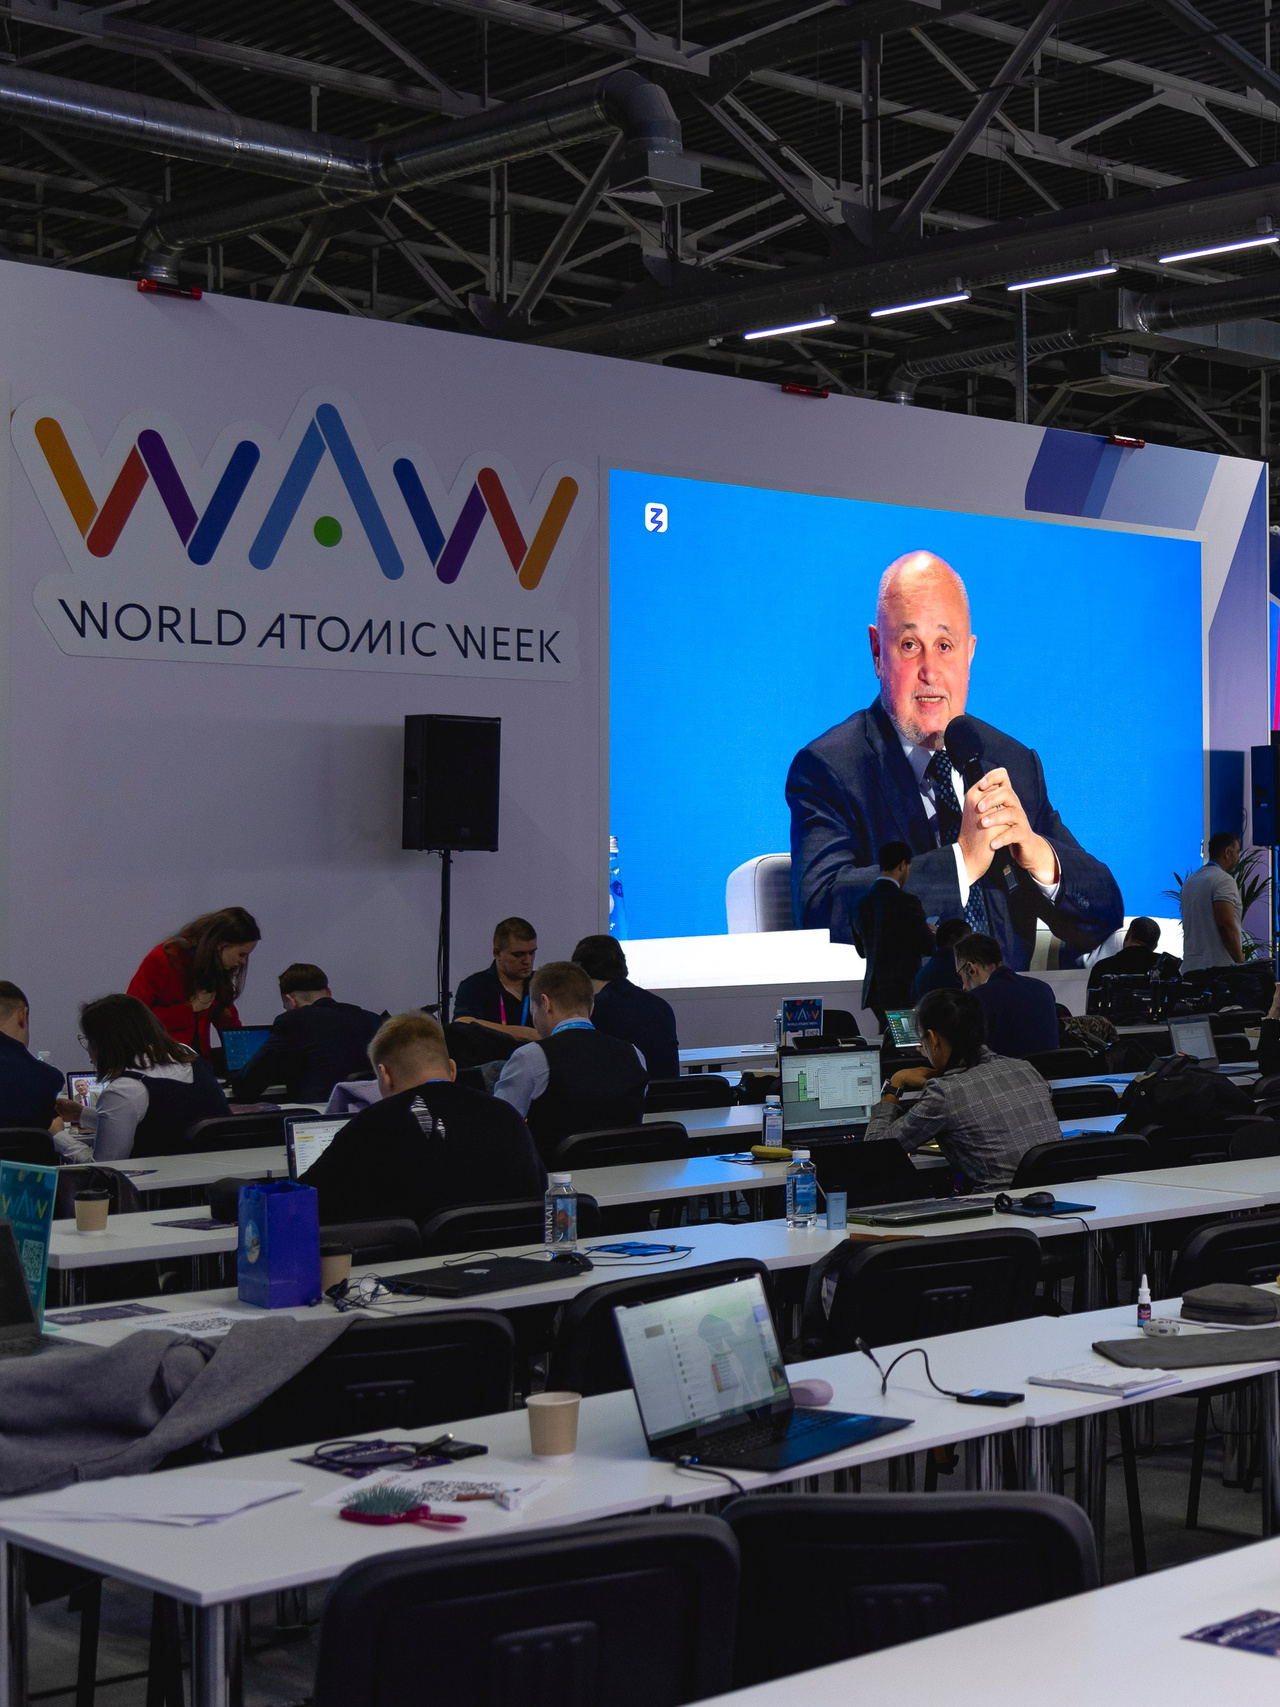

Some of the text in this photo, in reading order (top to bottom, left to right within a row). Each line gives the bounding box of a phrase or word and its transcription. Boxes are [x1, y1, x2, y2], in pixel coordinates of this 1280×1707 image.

[34, 403, 579, 590] WAW
[58, 599, 561, 664] WORLD ATOMIC WEEK
[545, 1204, 553, 1243] BAIKAL
